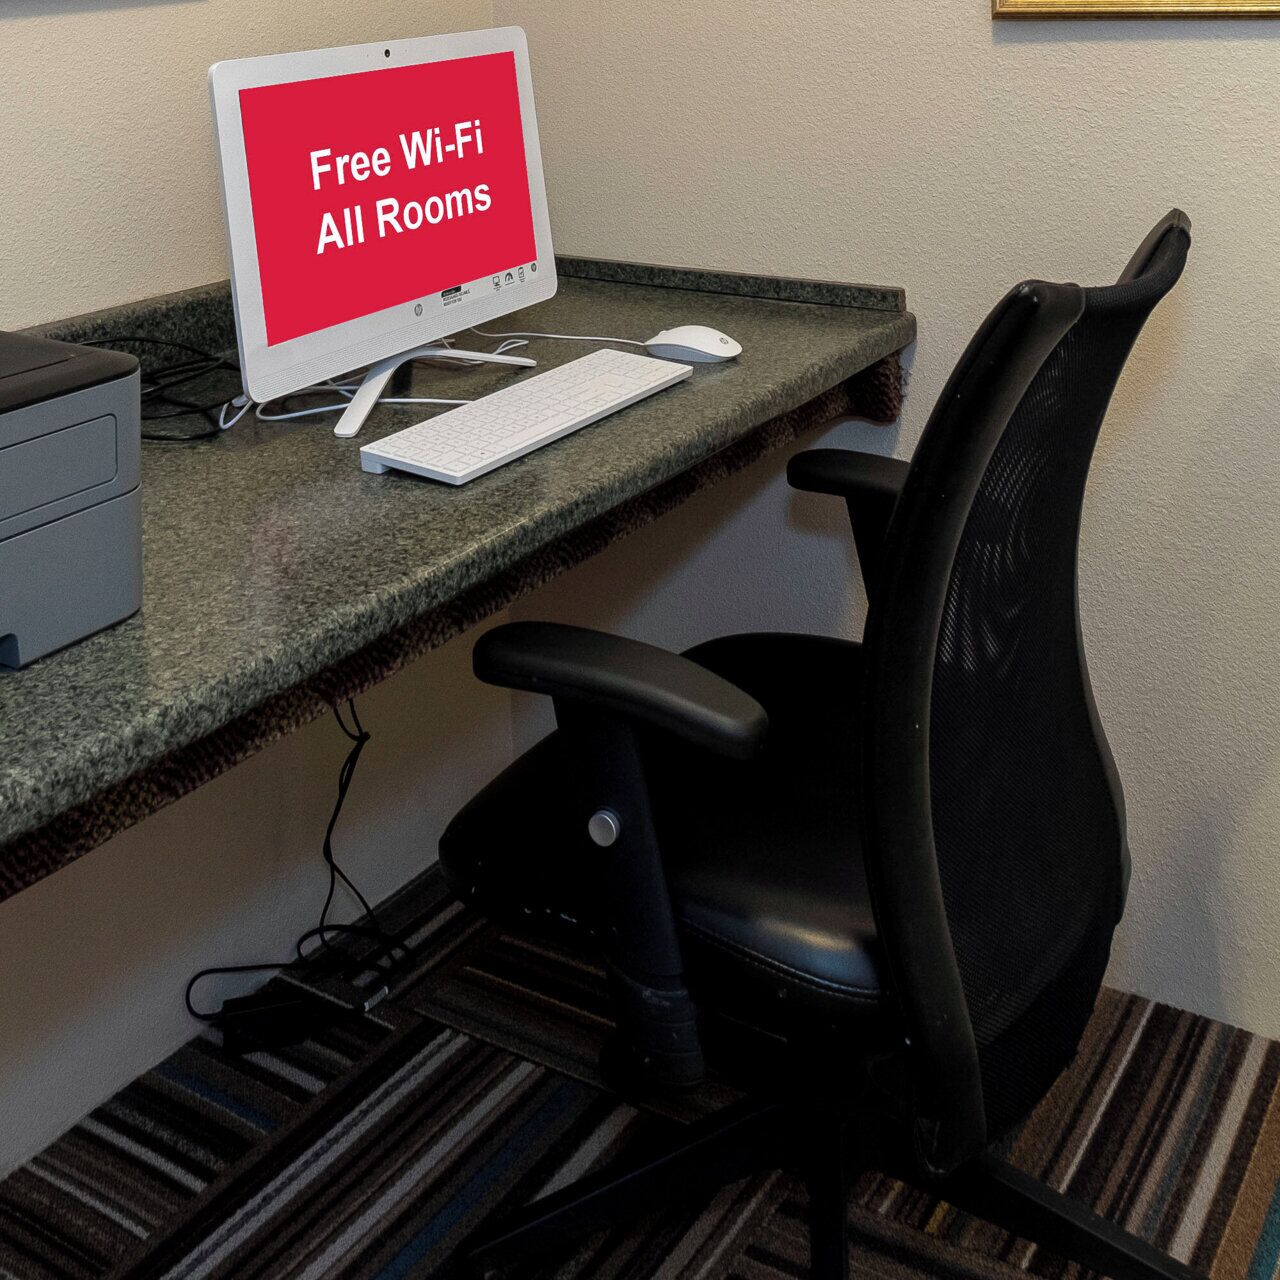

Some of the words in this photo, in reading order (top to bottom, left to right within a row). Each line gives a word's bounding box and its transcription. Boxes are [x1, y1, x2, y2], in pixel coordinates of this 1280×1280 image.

[310, 148, 391, 191] Free
[399, 120, 484, 170] Wi-Fi
[317, 206, 365, 254] All
[376, 184, 492, 238] Rooms
